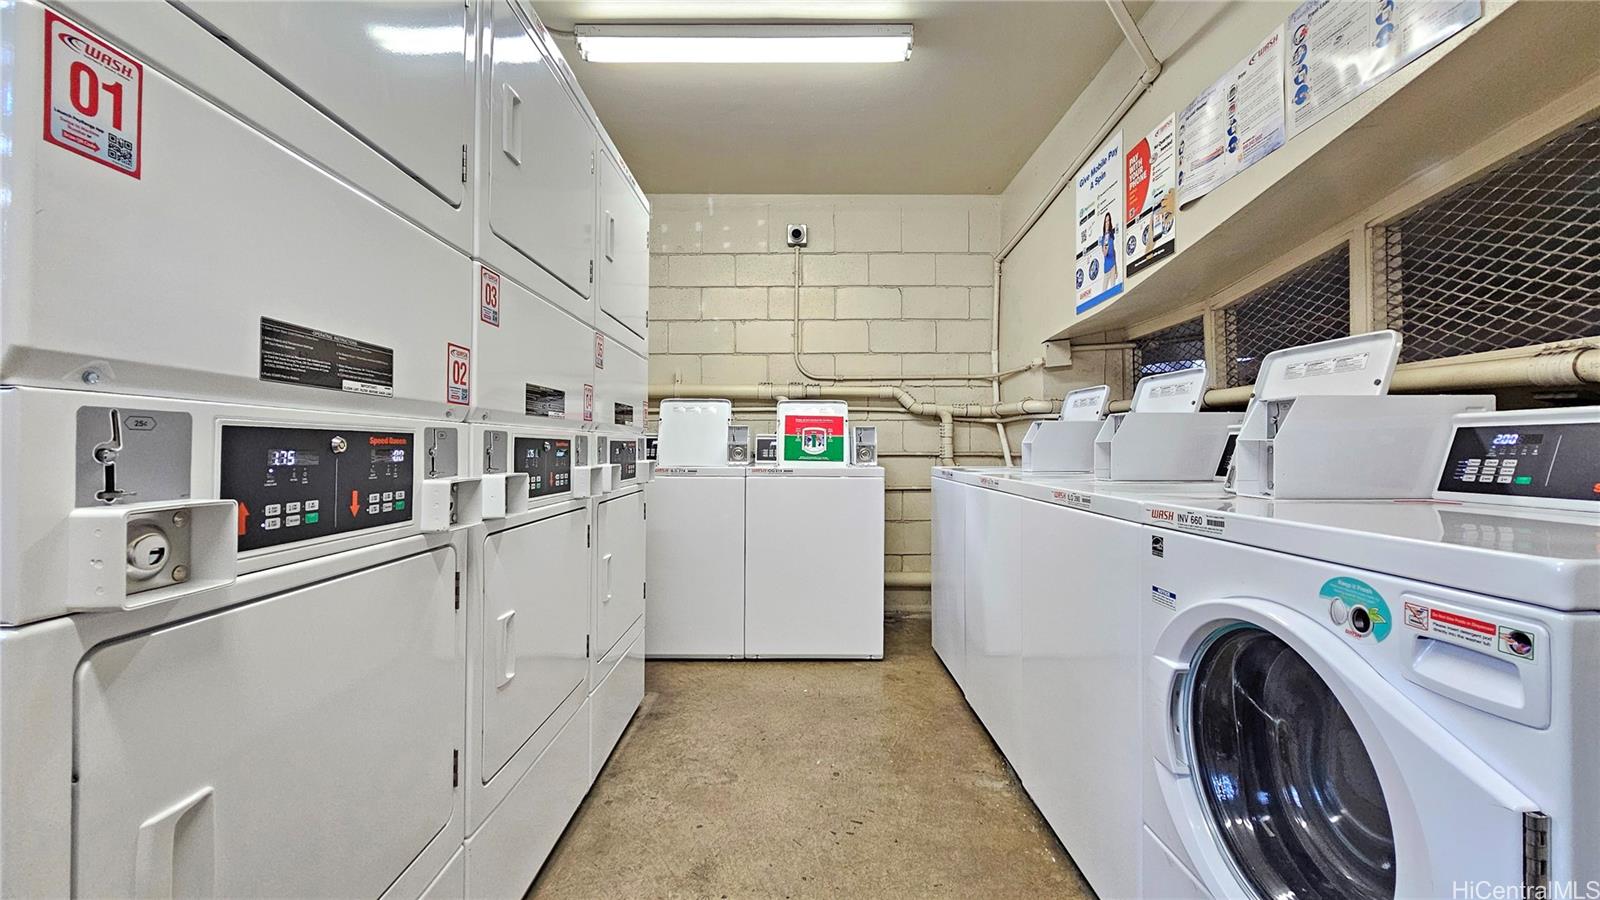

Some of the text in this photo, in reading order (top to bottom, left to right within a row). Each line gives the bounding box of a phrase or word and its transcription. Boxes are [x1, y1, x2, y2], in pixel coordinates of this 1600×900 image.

[85, 44, 132, 78] WASH
[70, 61, 123, 132] 01
[1079, 146, 1119, 188] Give Mobile Pay
[1129, 152, 1139, 168] PAY
[1129, 157, 1143, 175] WITH
[1094, 171, 1106, 186] Spin
[1129, 165, 1144, 183] YOUR
[1129, 169, 1148, 191] PHONE
[485, 283, 497, 308] 03
[453, 360, 467, 386] 02
[134, 419, 148, 427] 25¢
[369, 436, 407, 446] Speed Queen
[1151, 508, 1203, 526] WASH INV 660
[1433, 621, 1446, 629] Please
[1460, 628, 1482, 638] detergent
[1465, 636, 1482, 645] washer
